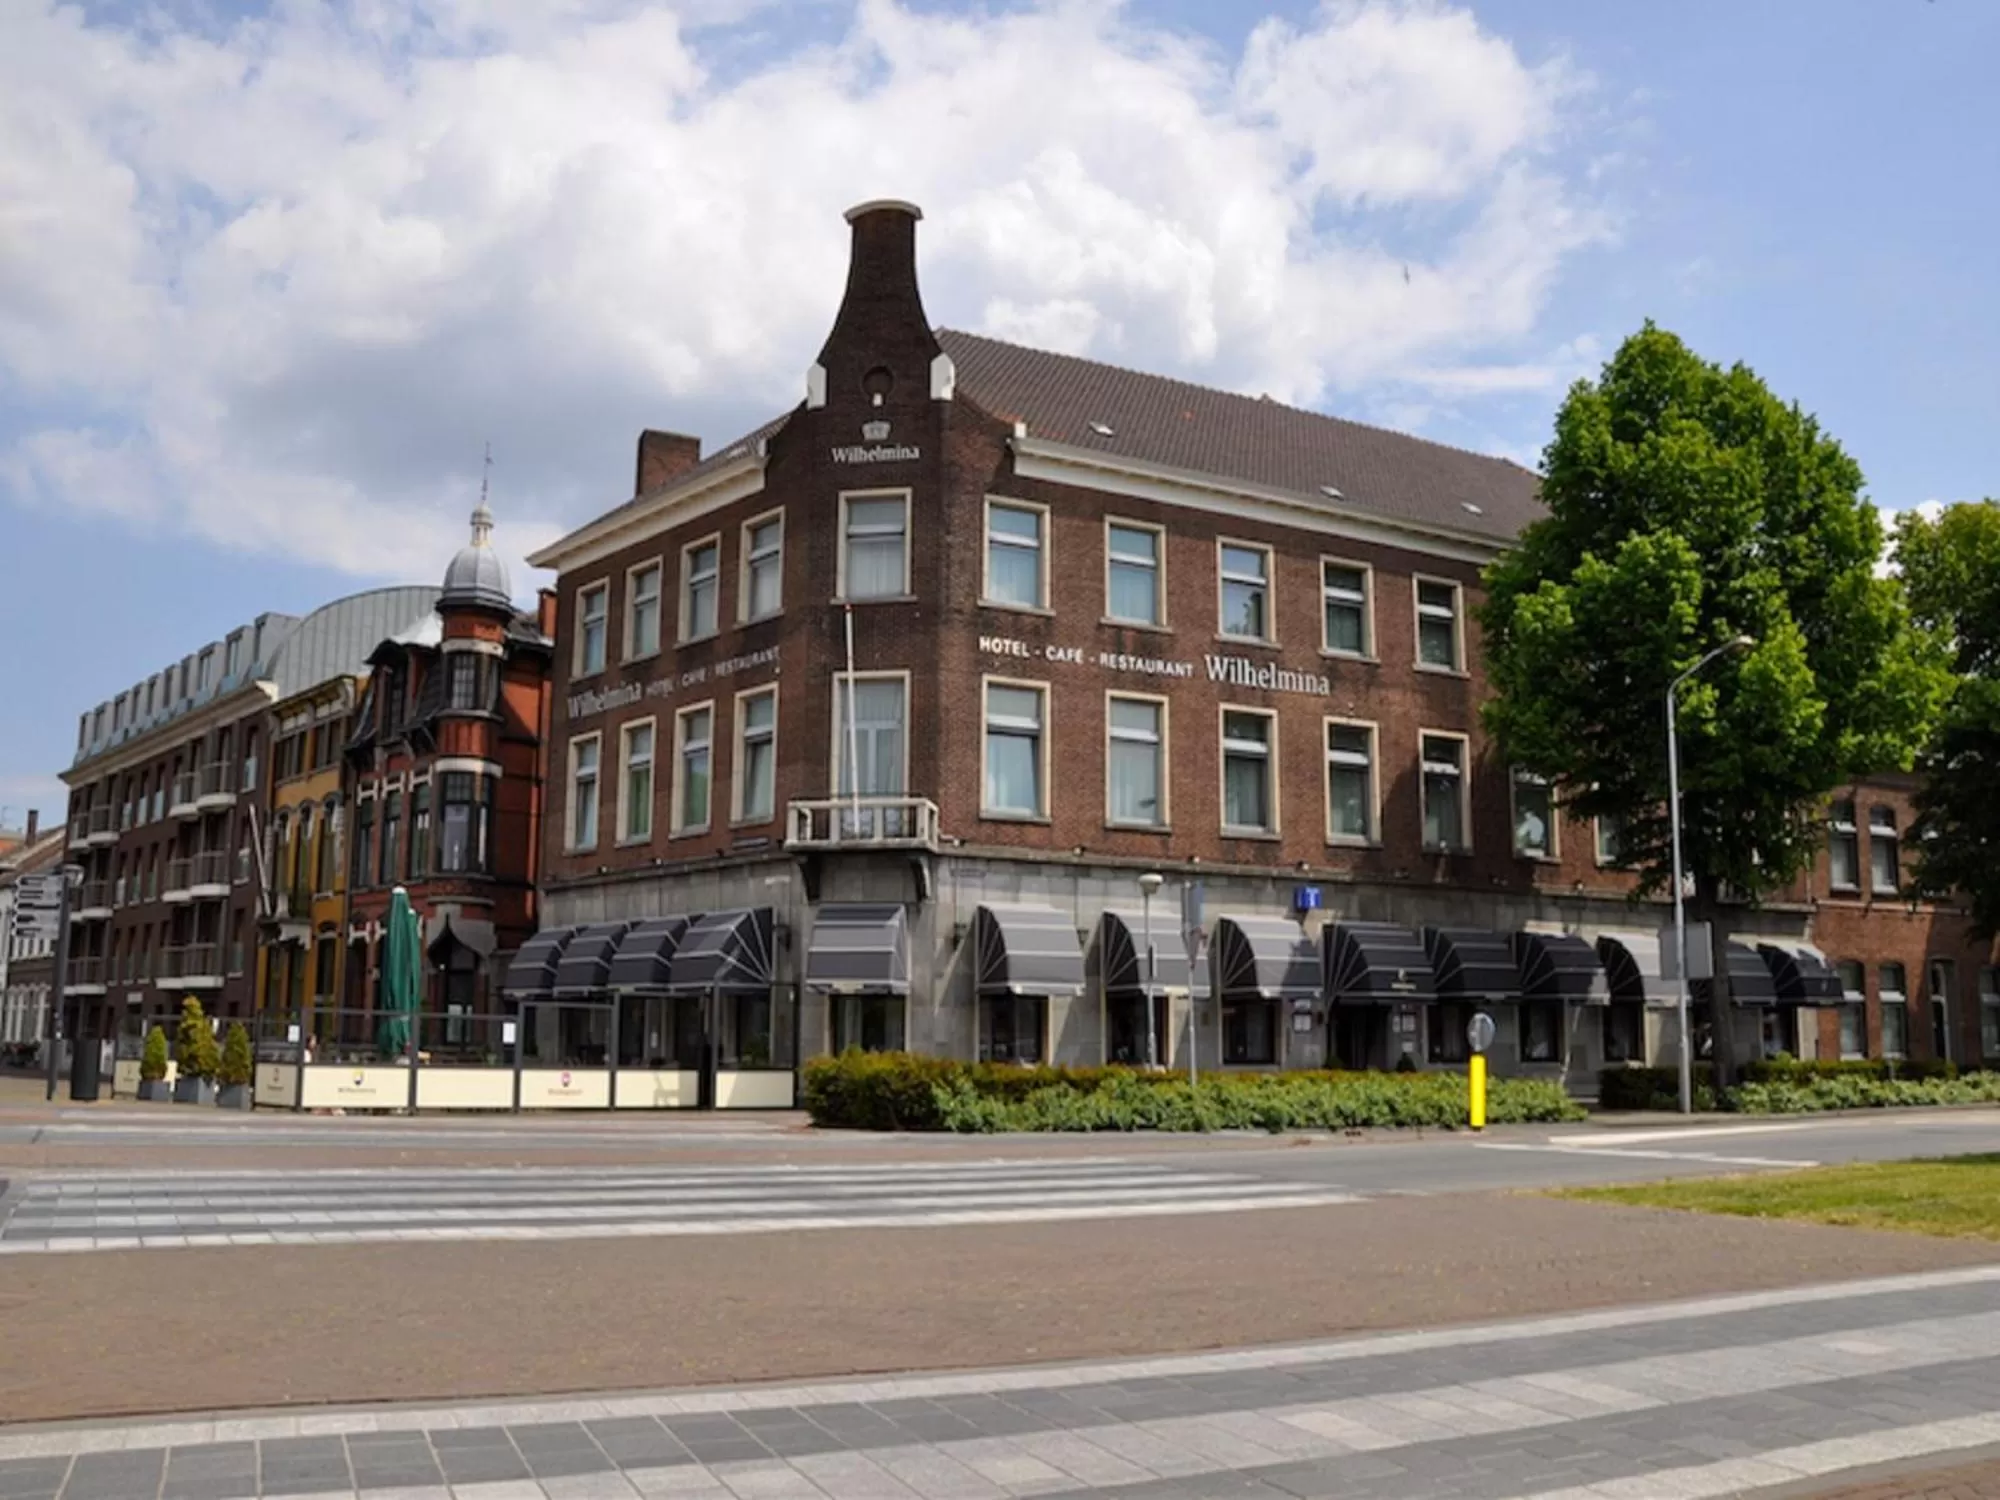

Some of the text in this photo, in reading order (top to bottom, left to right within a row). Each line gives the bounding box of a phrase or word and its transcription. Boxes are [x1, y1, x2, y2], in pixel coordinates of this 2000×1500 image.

[831, 444, 920, 464] Wilhelmina
[978, 635, 1030, 658] HOTEL
[1100, 652, 1193, 677] RESTAURANT
[1204, 653, 1331, 696] Wilhelmina
